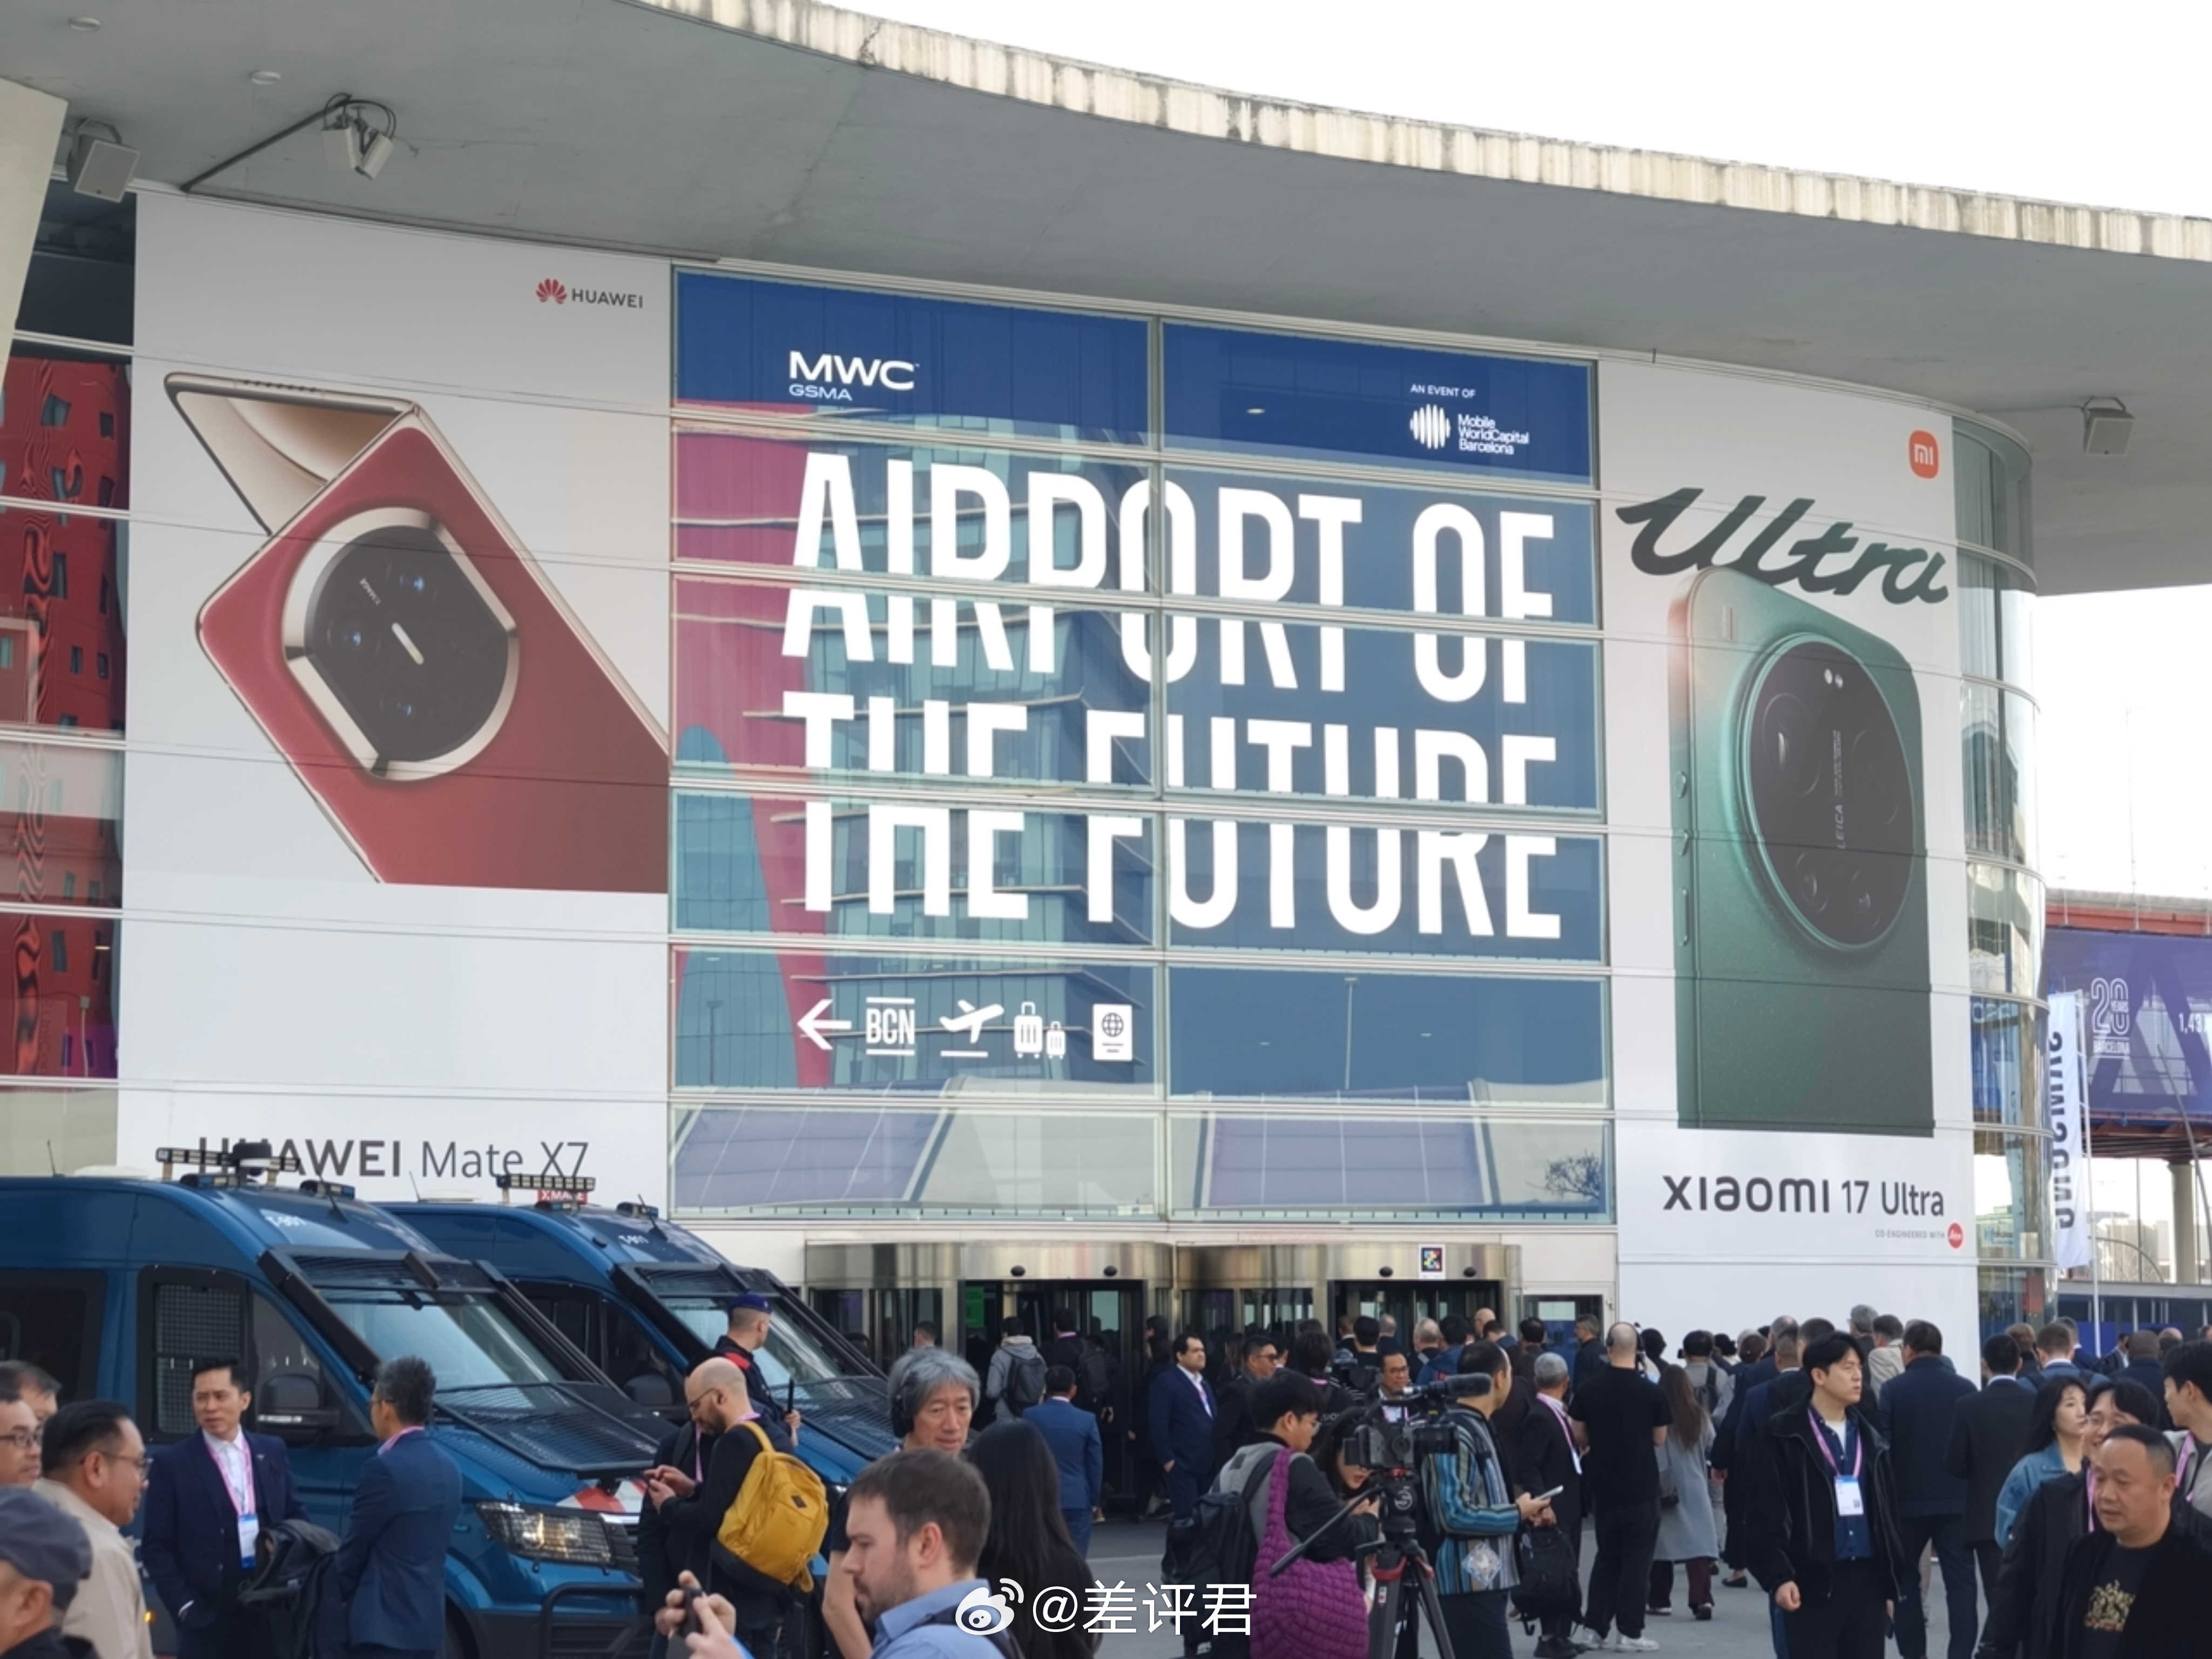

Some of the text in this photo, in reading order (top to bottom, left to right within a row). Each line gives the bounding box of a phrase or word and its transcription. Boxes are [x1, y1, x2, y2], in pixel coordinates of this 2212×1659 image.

[571, 288, 644, 308] HUAWEI
[789, 350, 915, 390] MWC
[788, 383, 853, 401] GSMA
[1410, 384, 1476, 398] AN EVENT OF
[1458, 414, 1495, 429] Mobile
[1459, 426, 1529, 444] WorldCapital
[1459, 439, 1514, 455] Barcelona
[1615, 487, 1948, 605] Ultra
[783, 452, 1554, 704] AIRPORT OF
[783, 691, 1561, 939] THE FUTURE
[2091, 977, 2130, 1035] 20
[866, 1007, 915, 1045] BCN
[199, 1137, 590, 1178] HAWEI Mate X7
[1842, 1181, 1870, 1213] 17
[1881, 1182, 1944, 1217] Ultra
